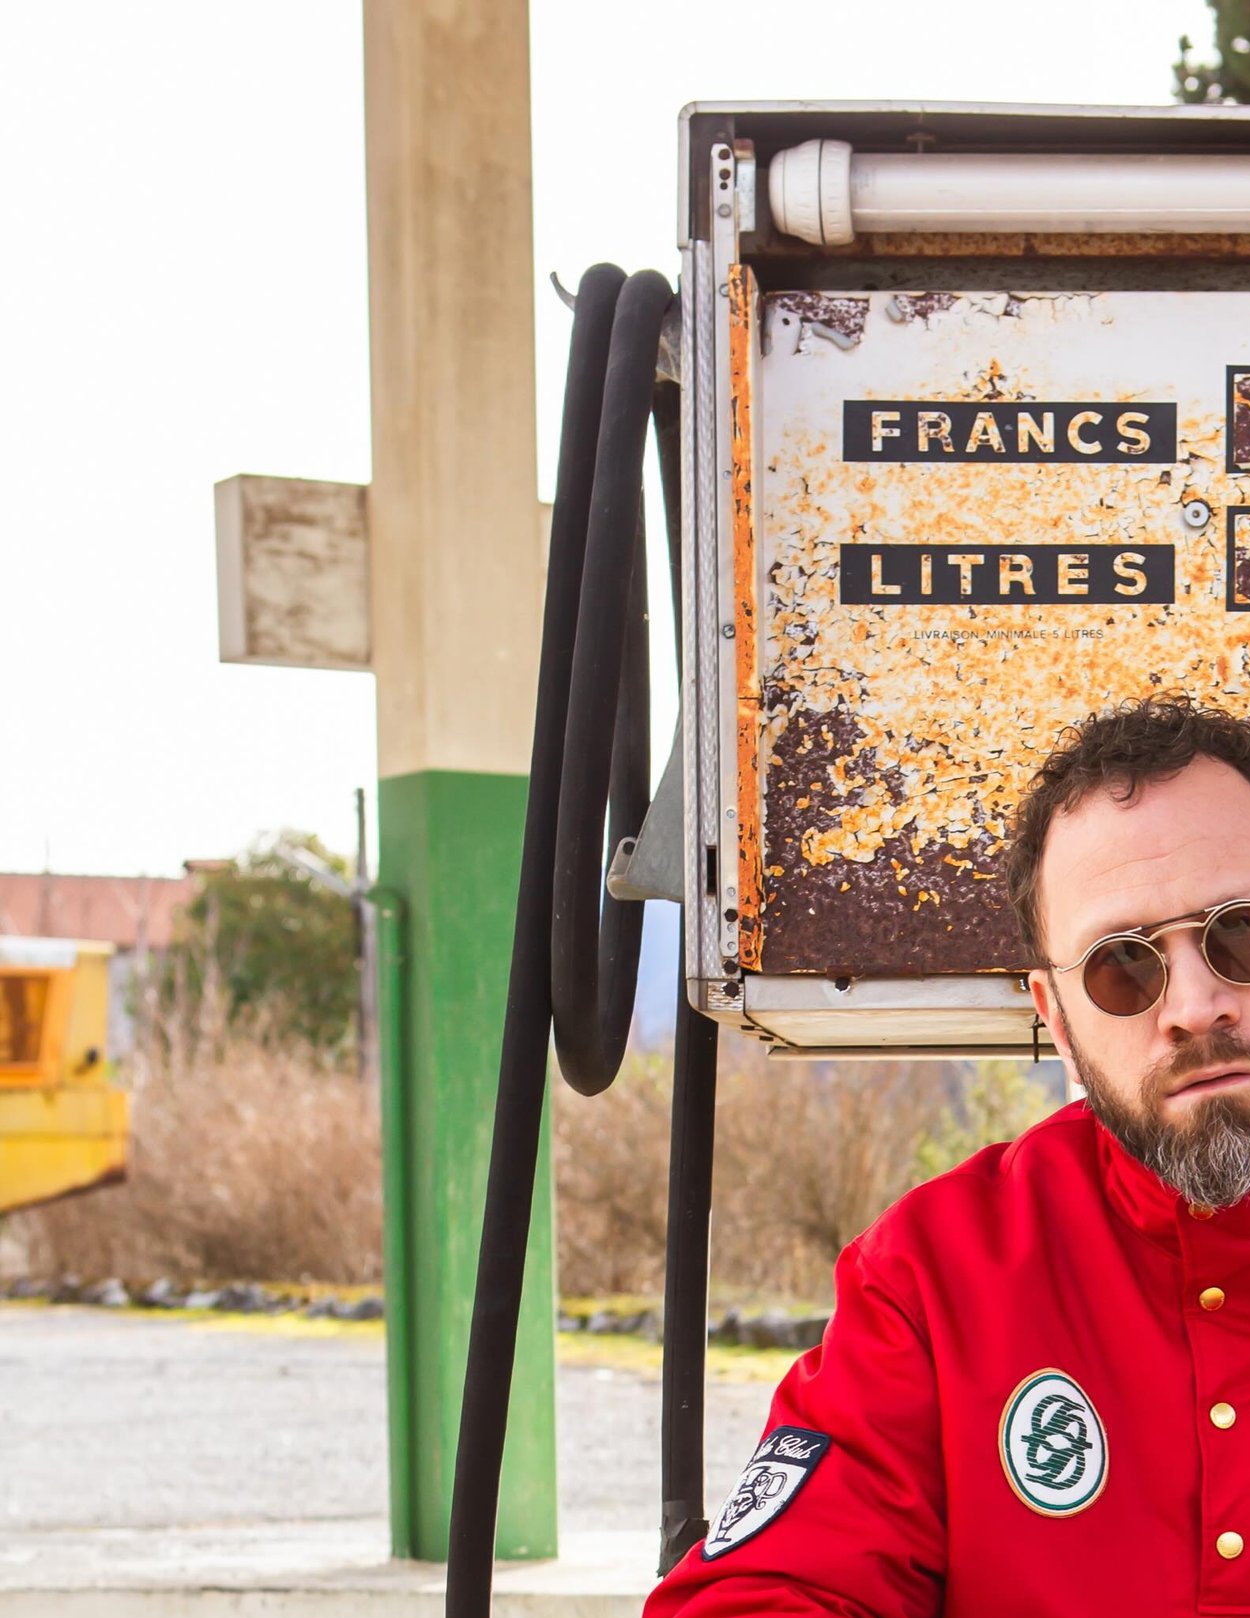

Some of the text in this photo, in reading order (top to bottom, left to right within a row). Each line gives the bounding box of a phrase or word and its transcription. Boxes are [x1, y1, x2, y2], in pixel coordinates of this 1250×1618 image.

[870, 411, 1151, 455] FRANCS
[870, 552, 1149, 596] LITRES
[914, 629, 1105, 640] LIVRAISON MINIMALE 5 LITRES
[774, 1434, 821, 1460] Club
